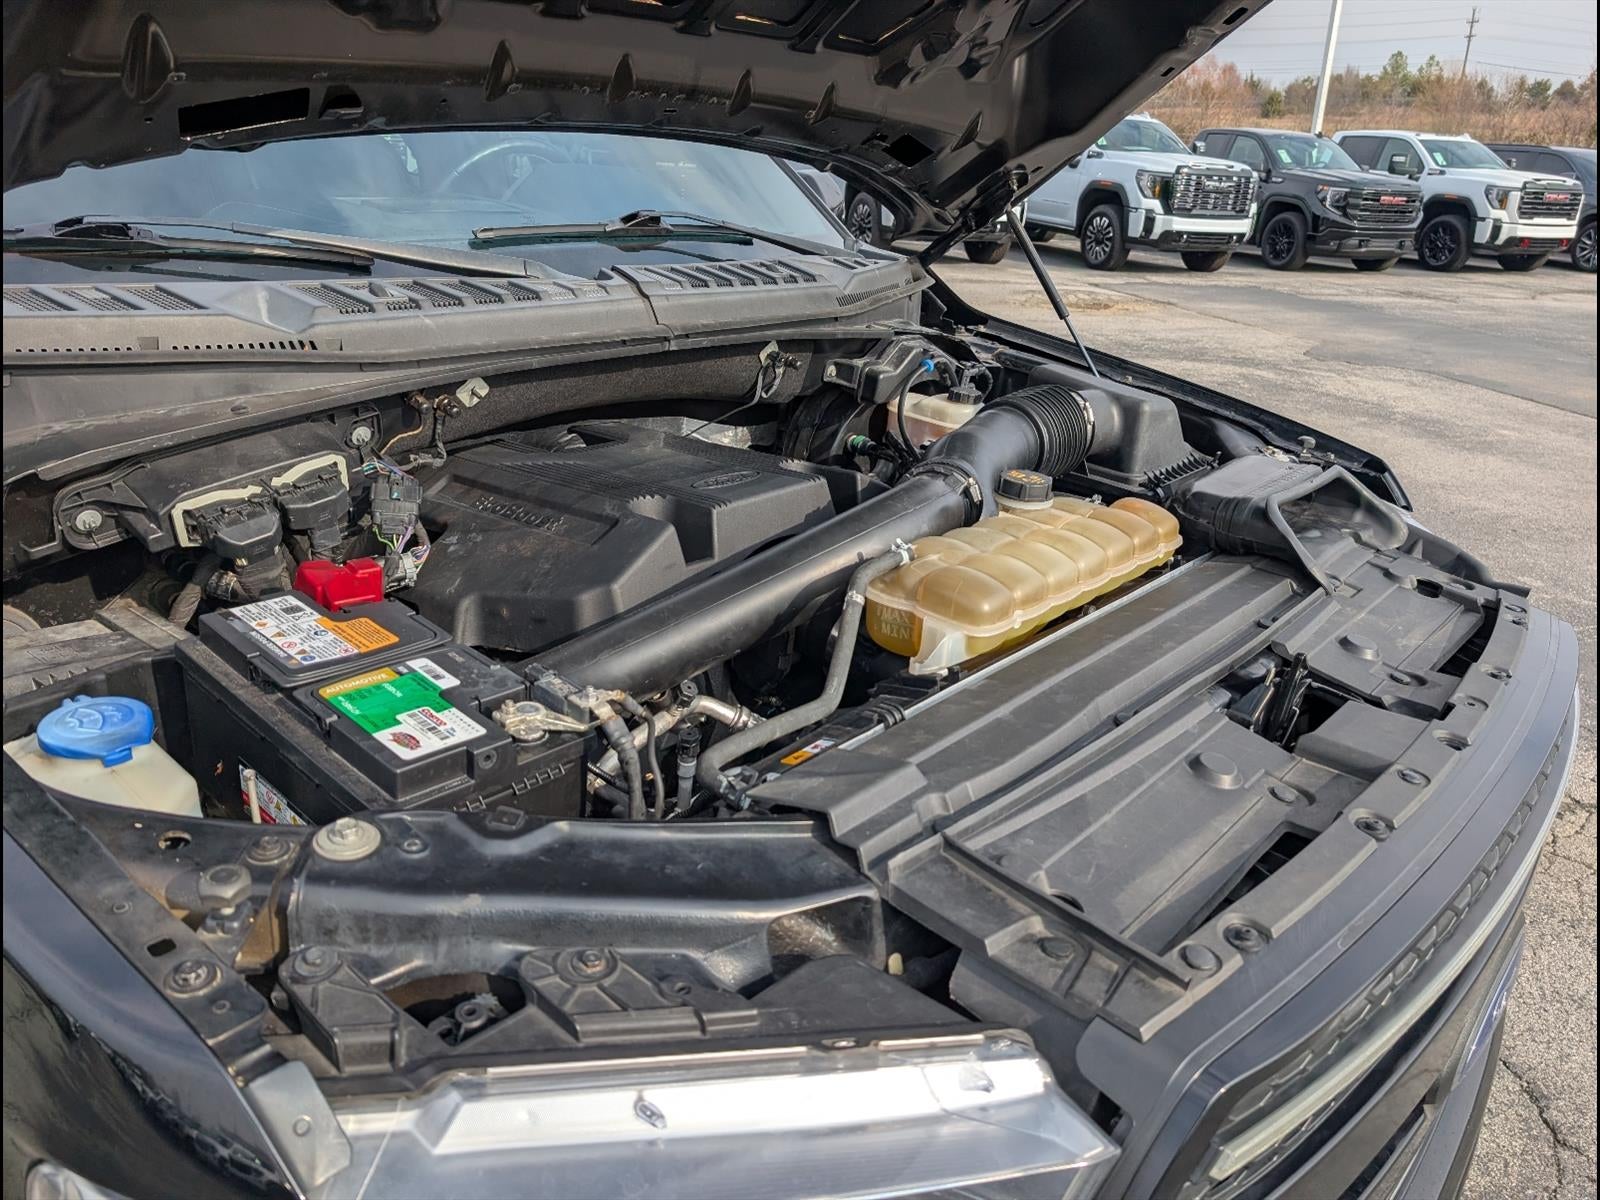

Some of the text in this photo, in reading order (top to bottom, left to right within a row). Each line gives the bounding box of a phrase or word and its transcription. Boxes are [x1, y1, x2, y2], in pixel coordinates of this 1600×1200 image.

[1380, 196, 1408, 205] GMC
[1545, 193, 1569, 203] GMC
[881, 606, 910, 624] MAX
[881, 622, 910, 640] MIN
[325, 673, 388, 693] AUTOMOTIVE
